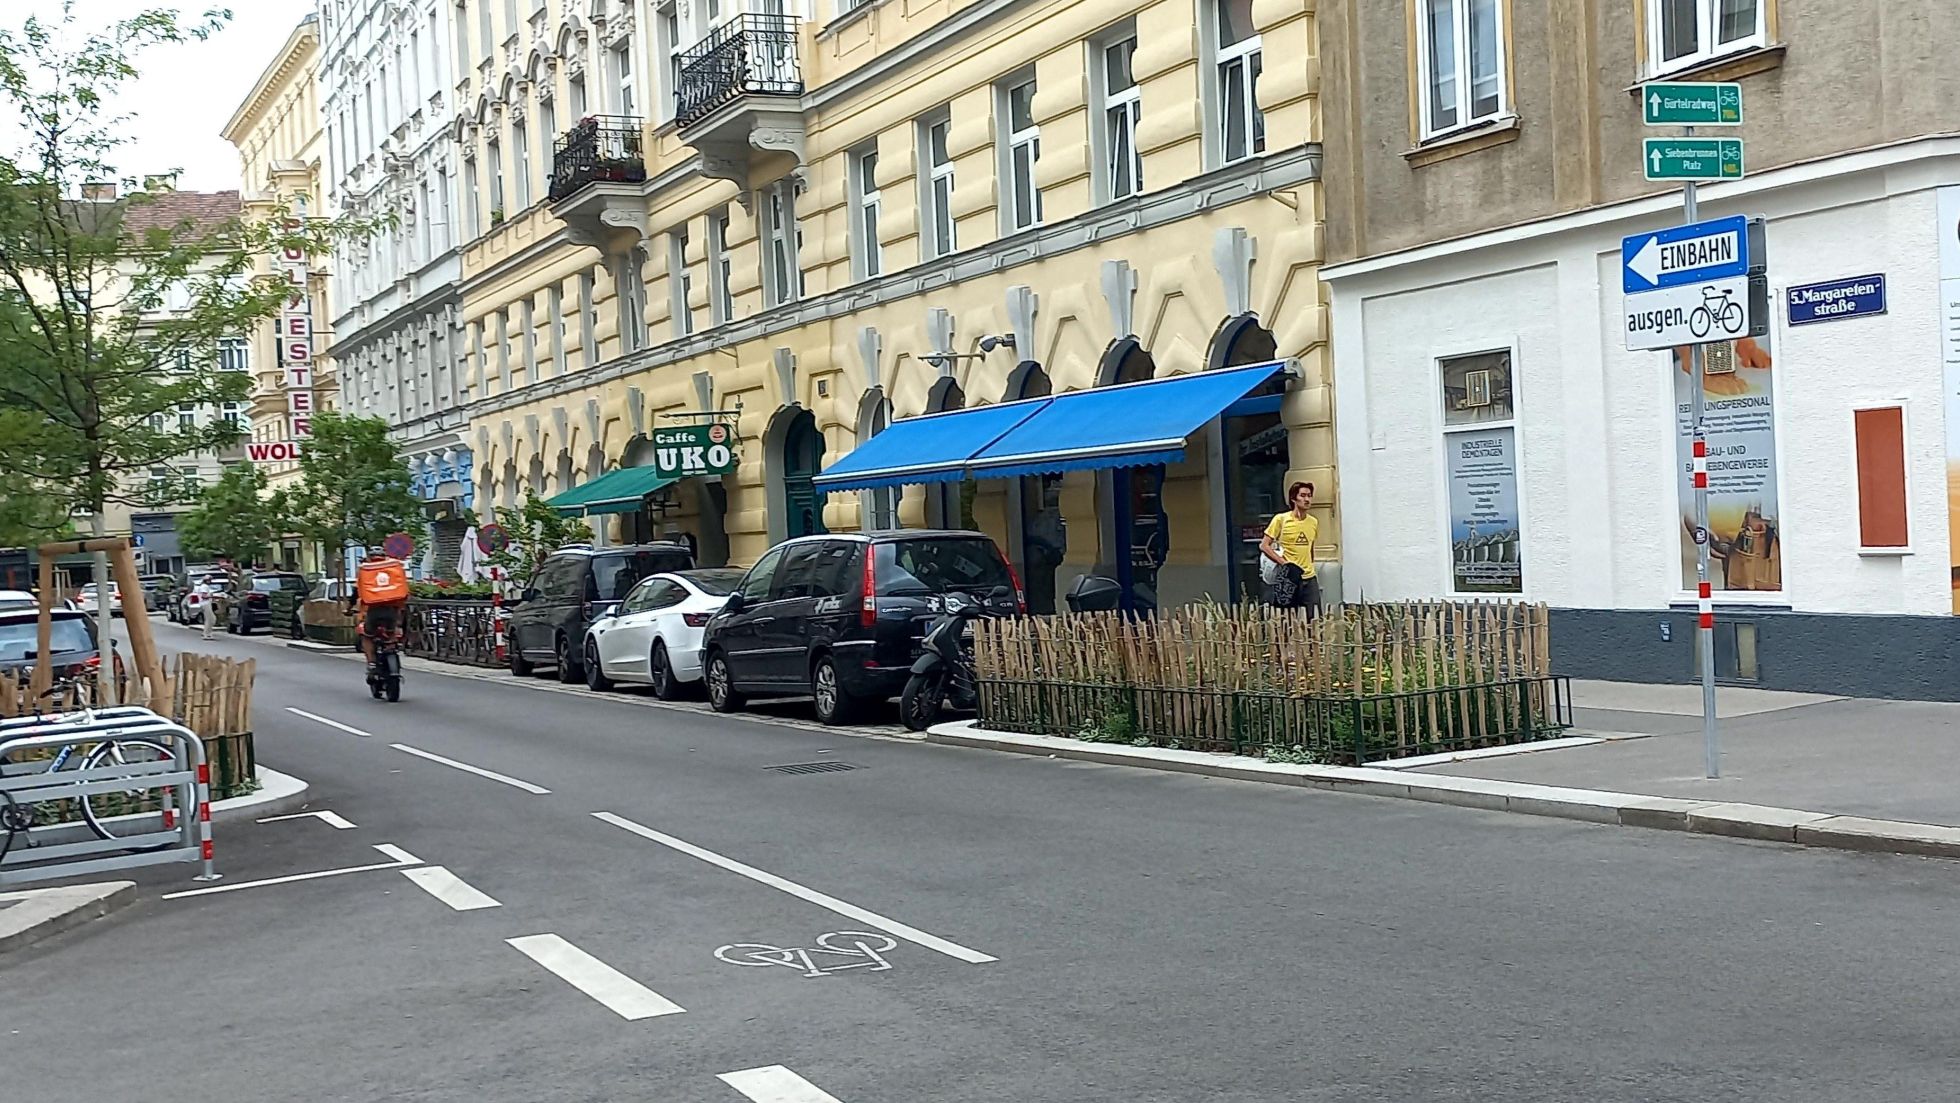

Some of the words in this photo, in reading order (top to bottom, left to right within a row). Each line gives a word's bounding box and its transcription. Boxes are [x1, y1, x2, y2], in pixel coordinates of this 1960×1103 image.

[1683, 160, 1702, 170] Platz
[1660, 235, 1732, 271] EINBAHN
[1814, 299, 1856, 316] straße
[1628, 306, 1688, 334] ausgen.
[655, 432, 697, 444] Caffe
[656, 444, 731, 472] UKO
[1727, 445, 1747, 455] UND
